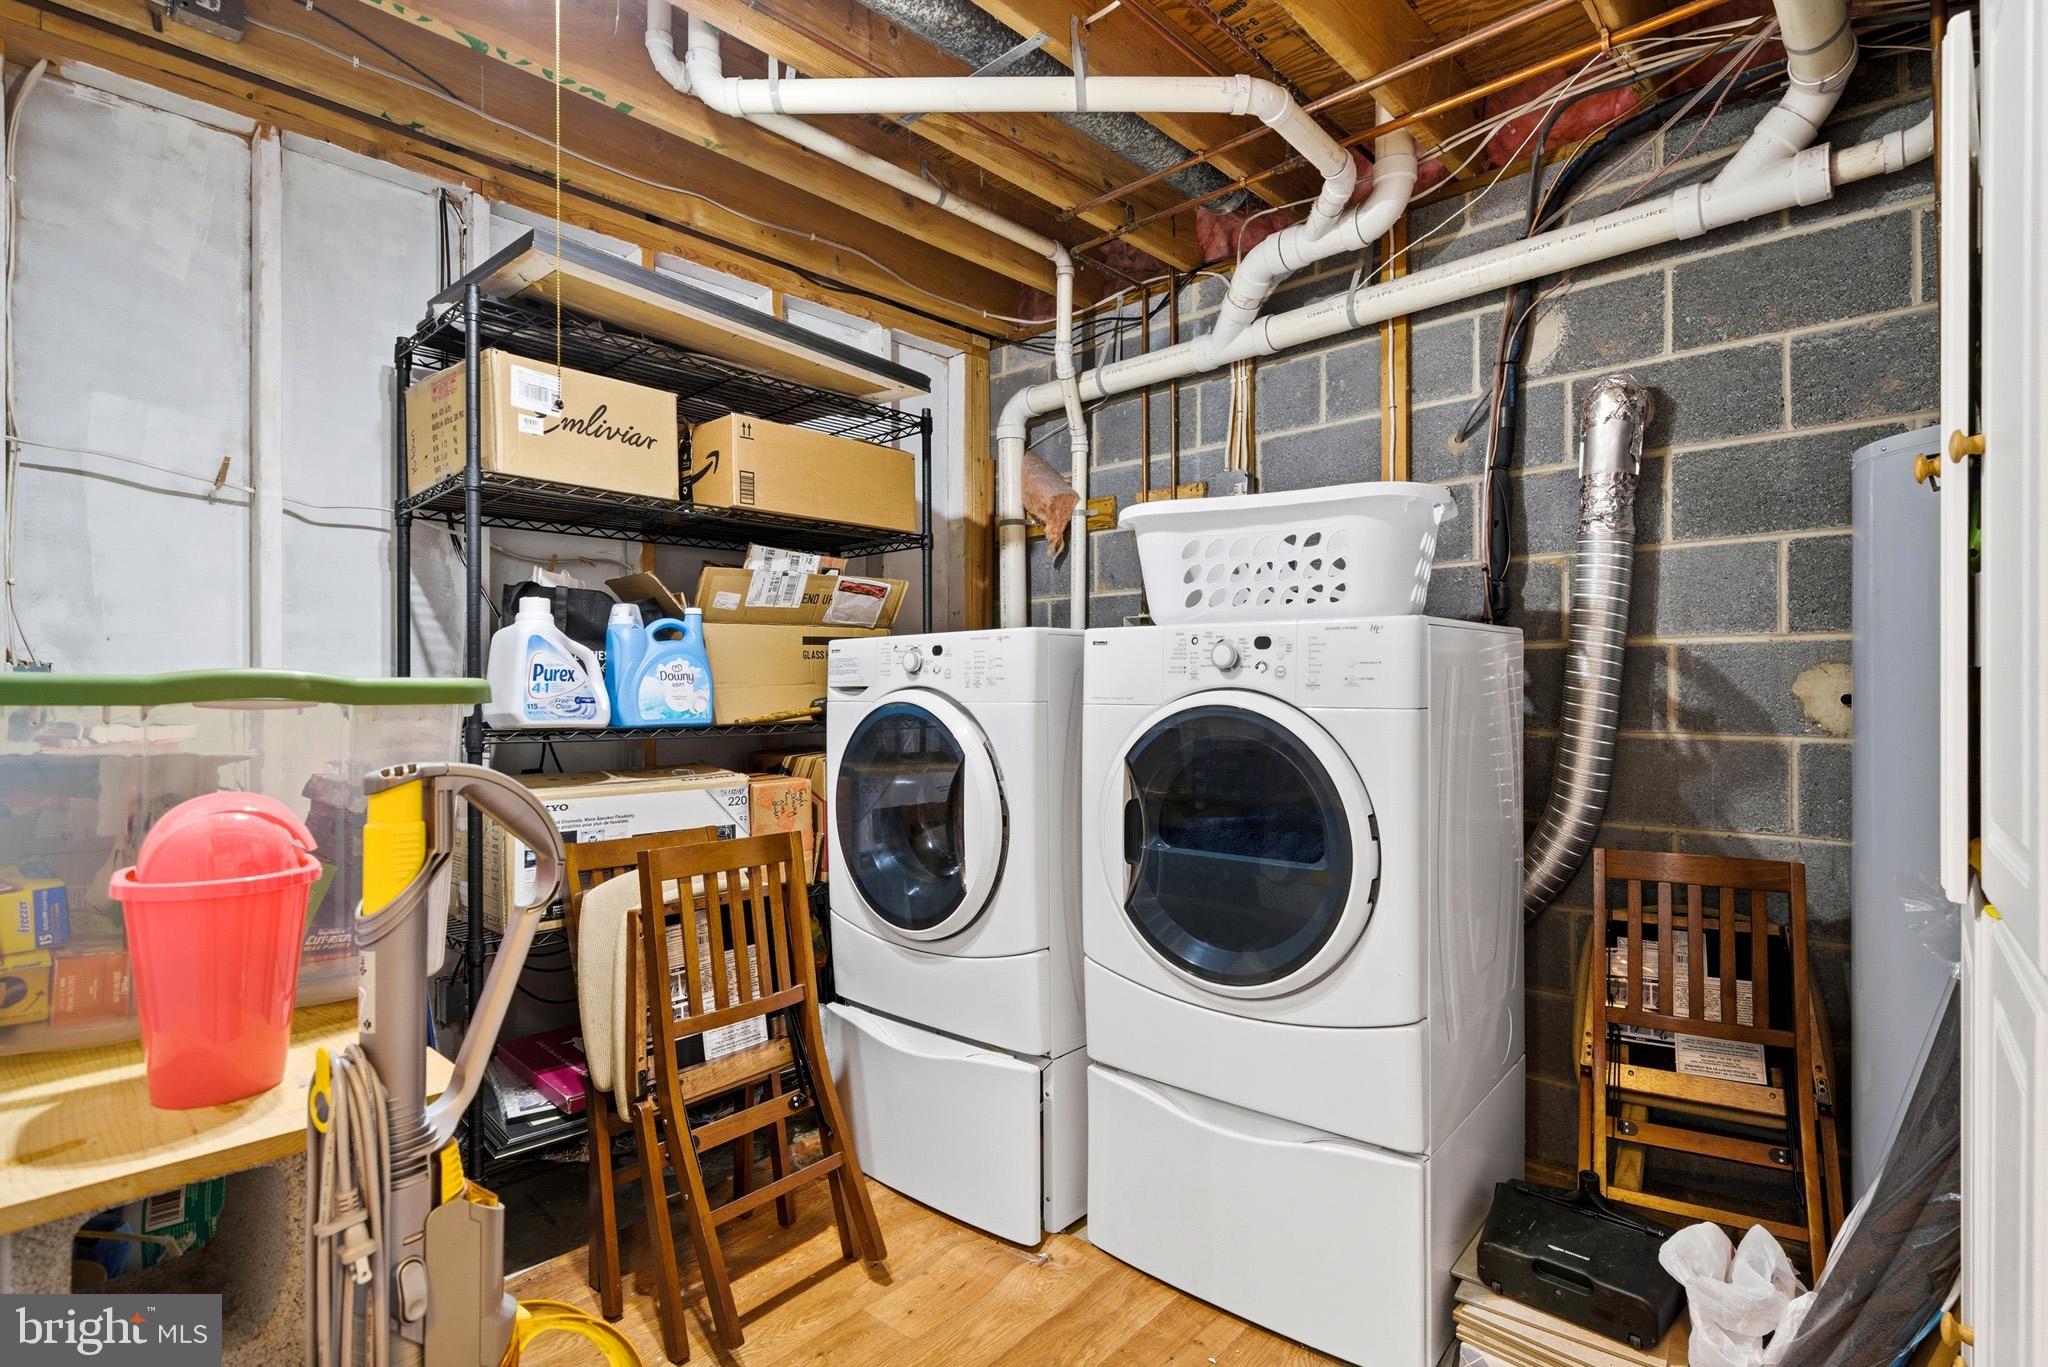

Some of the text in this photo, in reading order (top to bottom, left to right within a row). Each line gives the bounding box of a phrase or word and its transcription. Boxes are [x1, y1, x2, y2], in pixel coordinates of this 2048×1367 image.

[1528, 207, 1669, 253] NOT FOR PRESSURE
[534, 404, 658, 450] mliviar
[802, 650, 825, 660] GLASS
[532, 663, 575, 682] Purex
[660, 670, 695, 685] Downy
[728, 795, 747, 807] 220
[39, 933, 53, 945] 15
